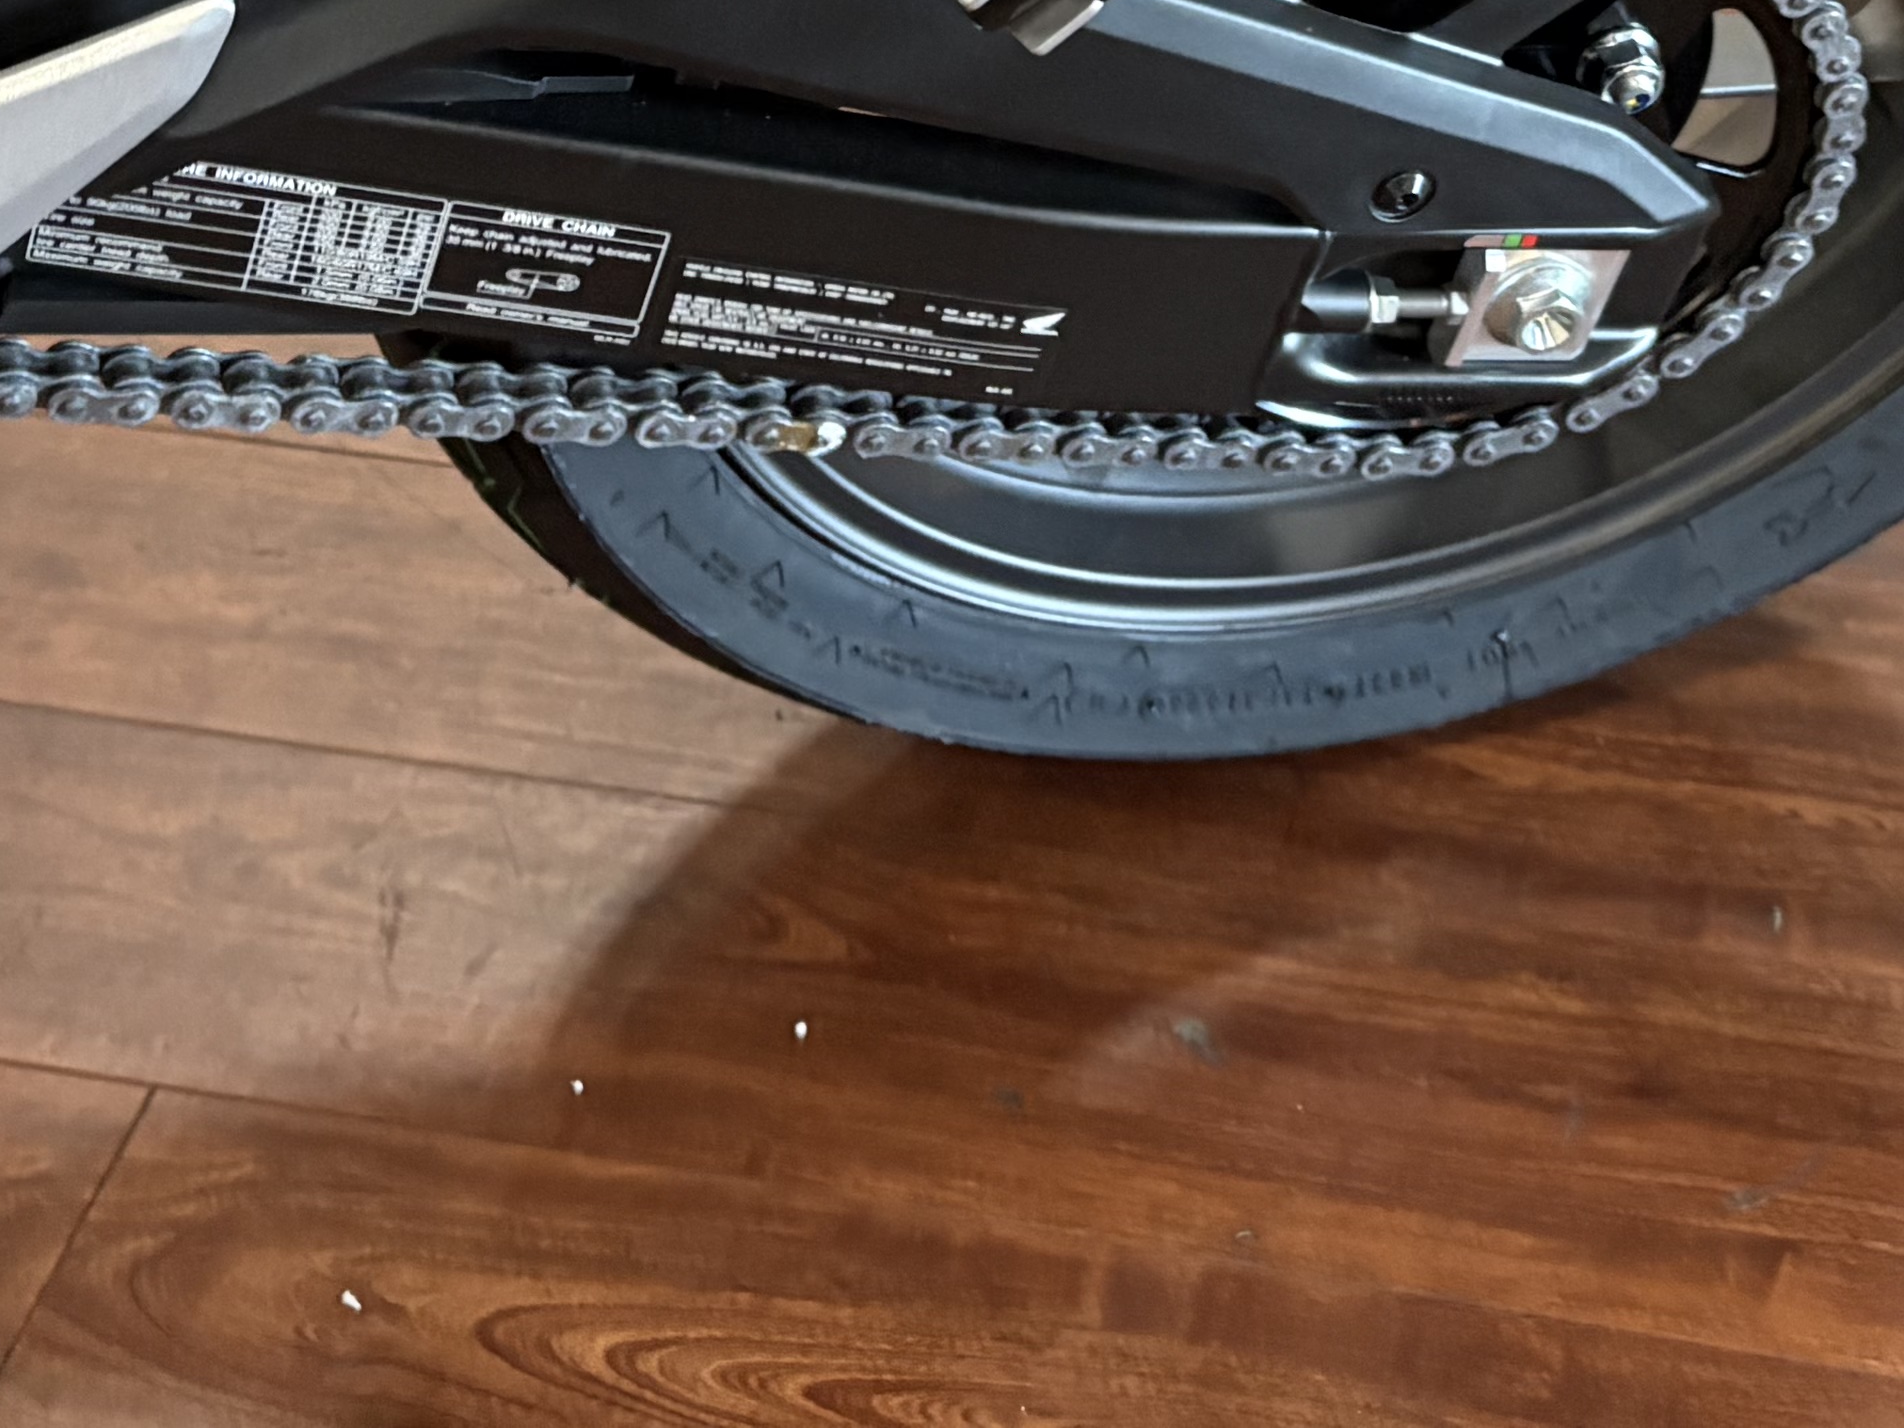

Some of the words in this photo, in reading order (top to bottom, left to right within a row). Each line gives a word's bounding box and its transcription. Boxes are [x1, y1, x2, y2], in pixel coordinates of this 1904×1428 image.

[215, 167, 336, 197] INFORMATION
[448, 223, 479, 238] Keep
[482, 228, 514, 241] chain
[518, 233, 566, 250] adjusted
[569, 241, 593, 253] and
[502, 210, 554, 229] DRIVE
[561, 220, 615, 238] CHAIN
